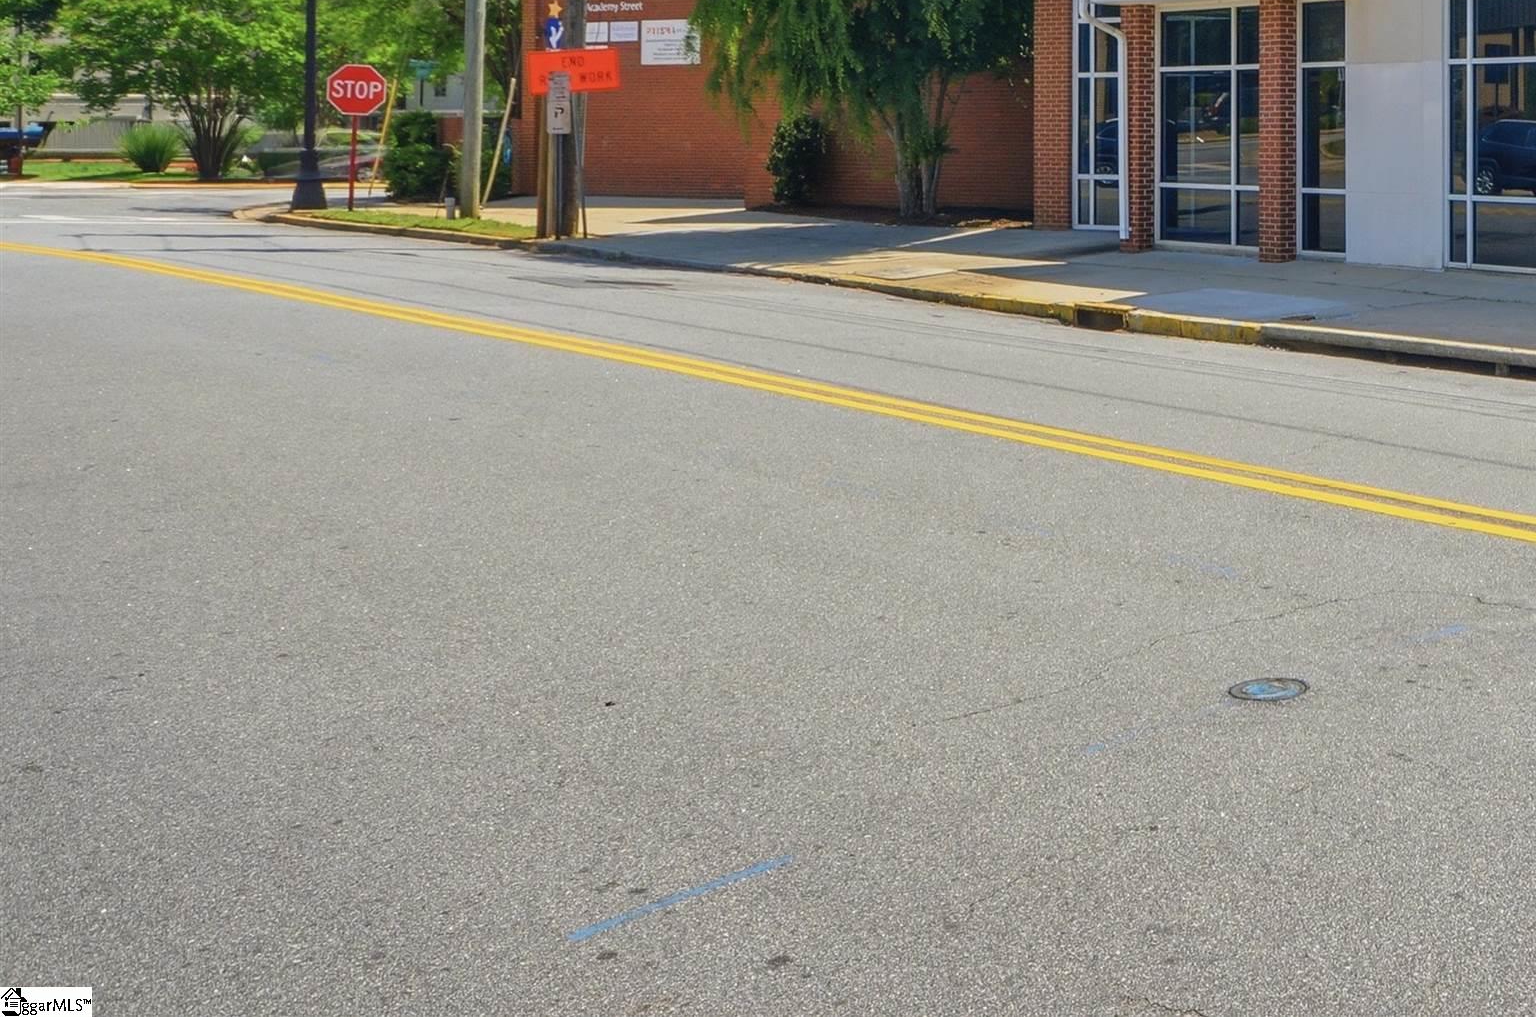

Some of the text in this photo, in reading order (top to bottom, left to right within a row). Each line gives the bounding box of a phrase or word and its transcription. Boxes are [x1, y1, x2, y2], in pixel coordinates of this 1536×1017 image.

[620, 1, 644, 11] Street
[561, 56, 585, 68] END
[579, 71, 613, 83] WORK
[331, 79, 382, 100] STOP
